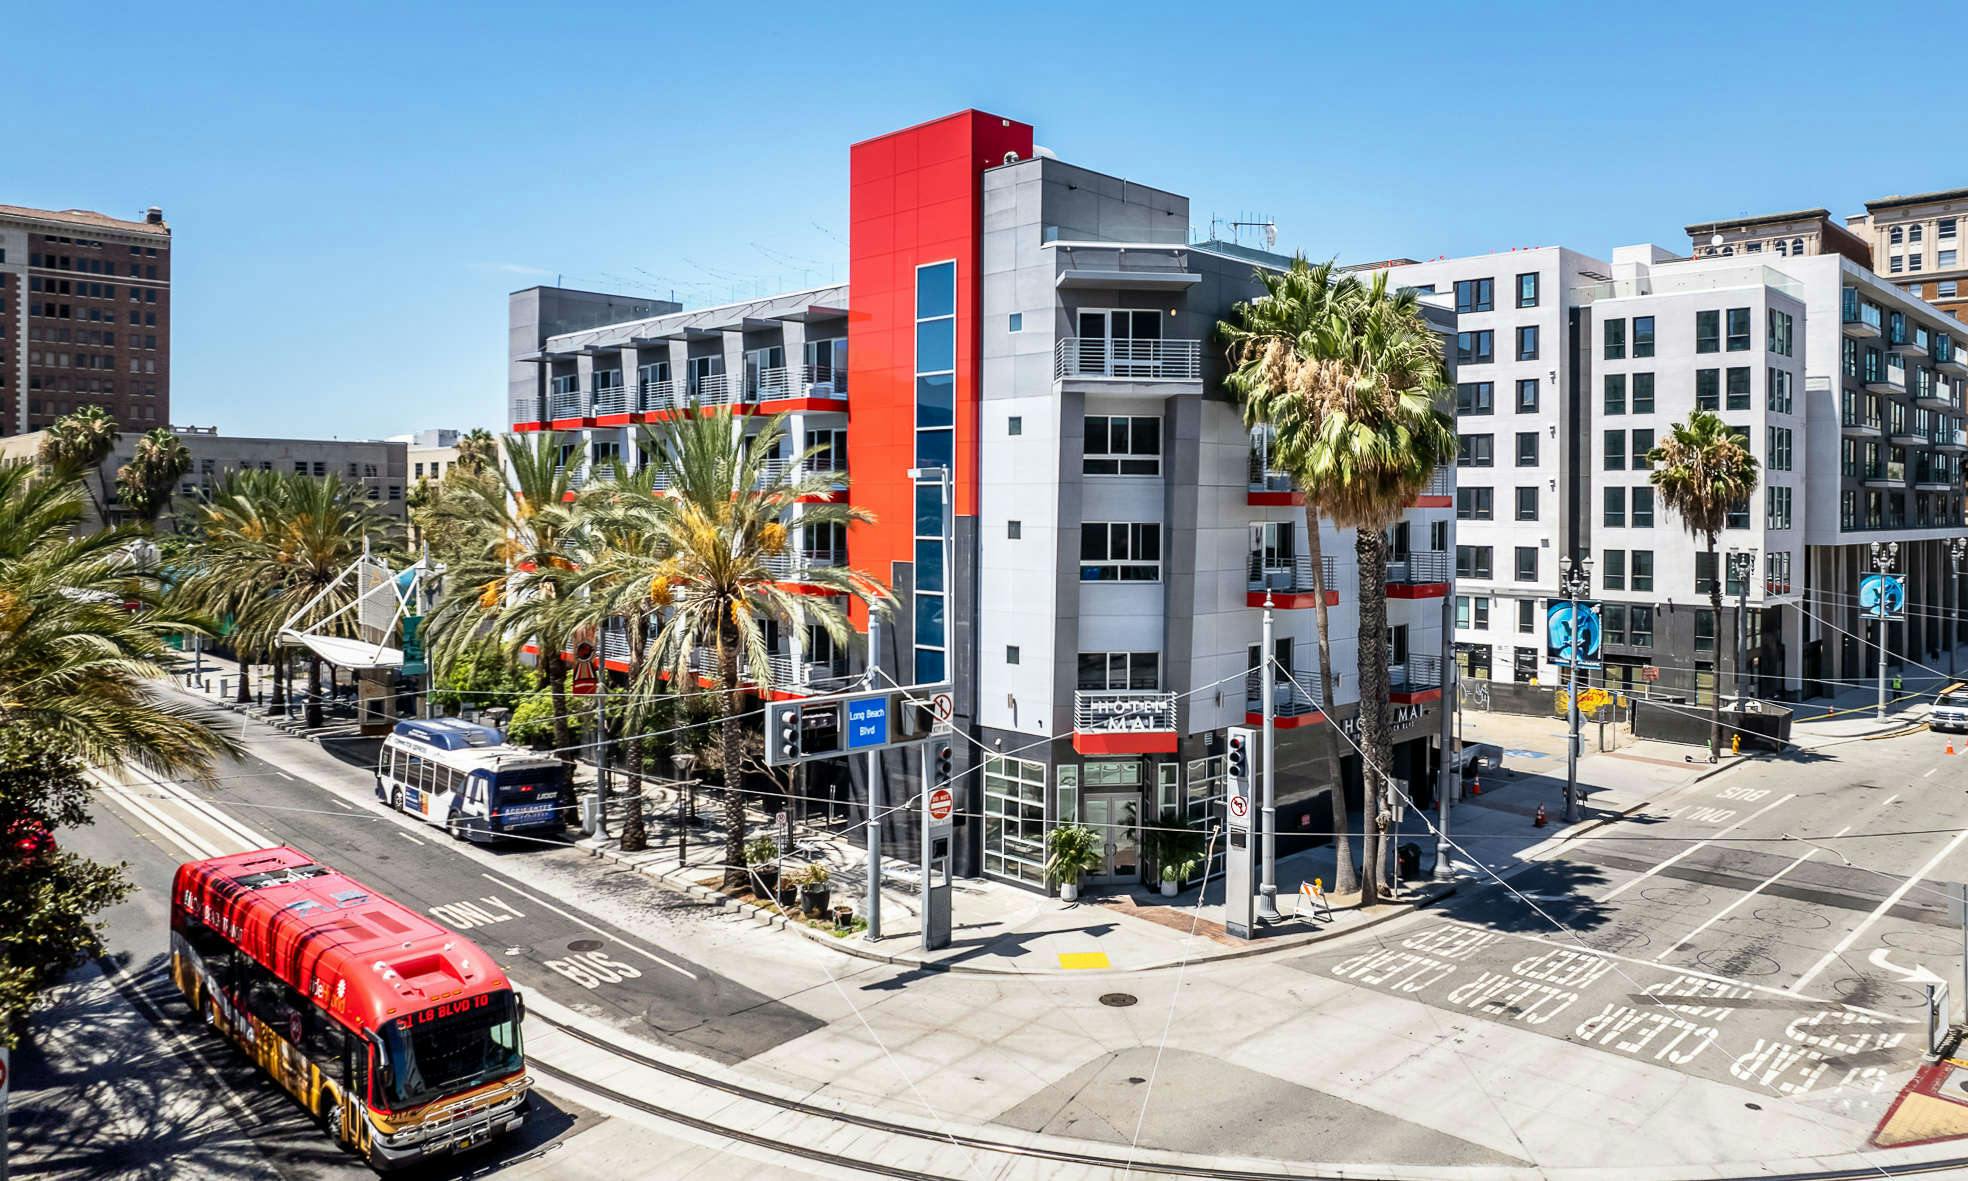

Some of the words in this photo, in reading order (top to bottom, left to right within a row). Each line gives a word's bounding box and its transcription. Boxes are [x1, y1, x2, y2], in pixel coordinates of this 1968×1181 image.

[849, 711, 865, 721] Long
[866, 708, 885, 719] Beach
[1098, 700, 1163, 714] HOTEL
[1107, 716, 1155, 732] MAI
[1398, 704, 1424, 723] MAI
[859, 725, 876, 736] Blvd
[1716, 786, 1772, 801] BUS
[428, 895, 526, 930] ONLY
[1402, 924, 1504, 961] KEEP
[543, 950, 642, 990] BUS
[1331, 946, 1457, 993] CLEAR
[1511, 949, 1619, 990] KEEP
[418, 1008, 435, 1025] LB
[437, 999, 471, 1019] BLVD
[1448, 970, 1580, 1025] CLEAR
[1640, 975, 1753, 1022] KEEP
[1575, 1003, 1719, 1065] CLEAR
